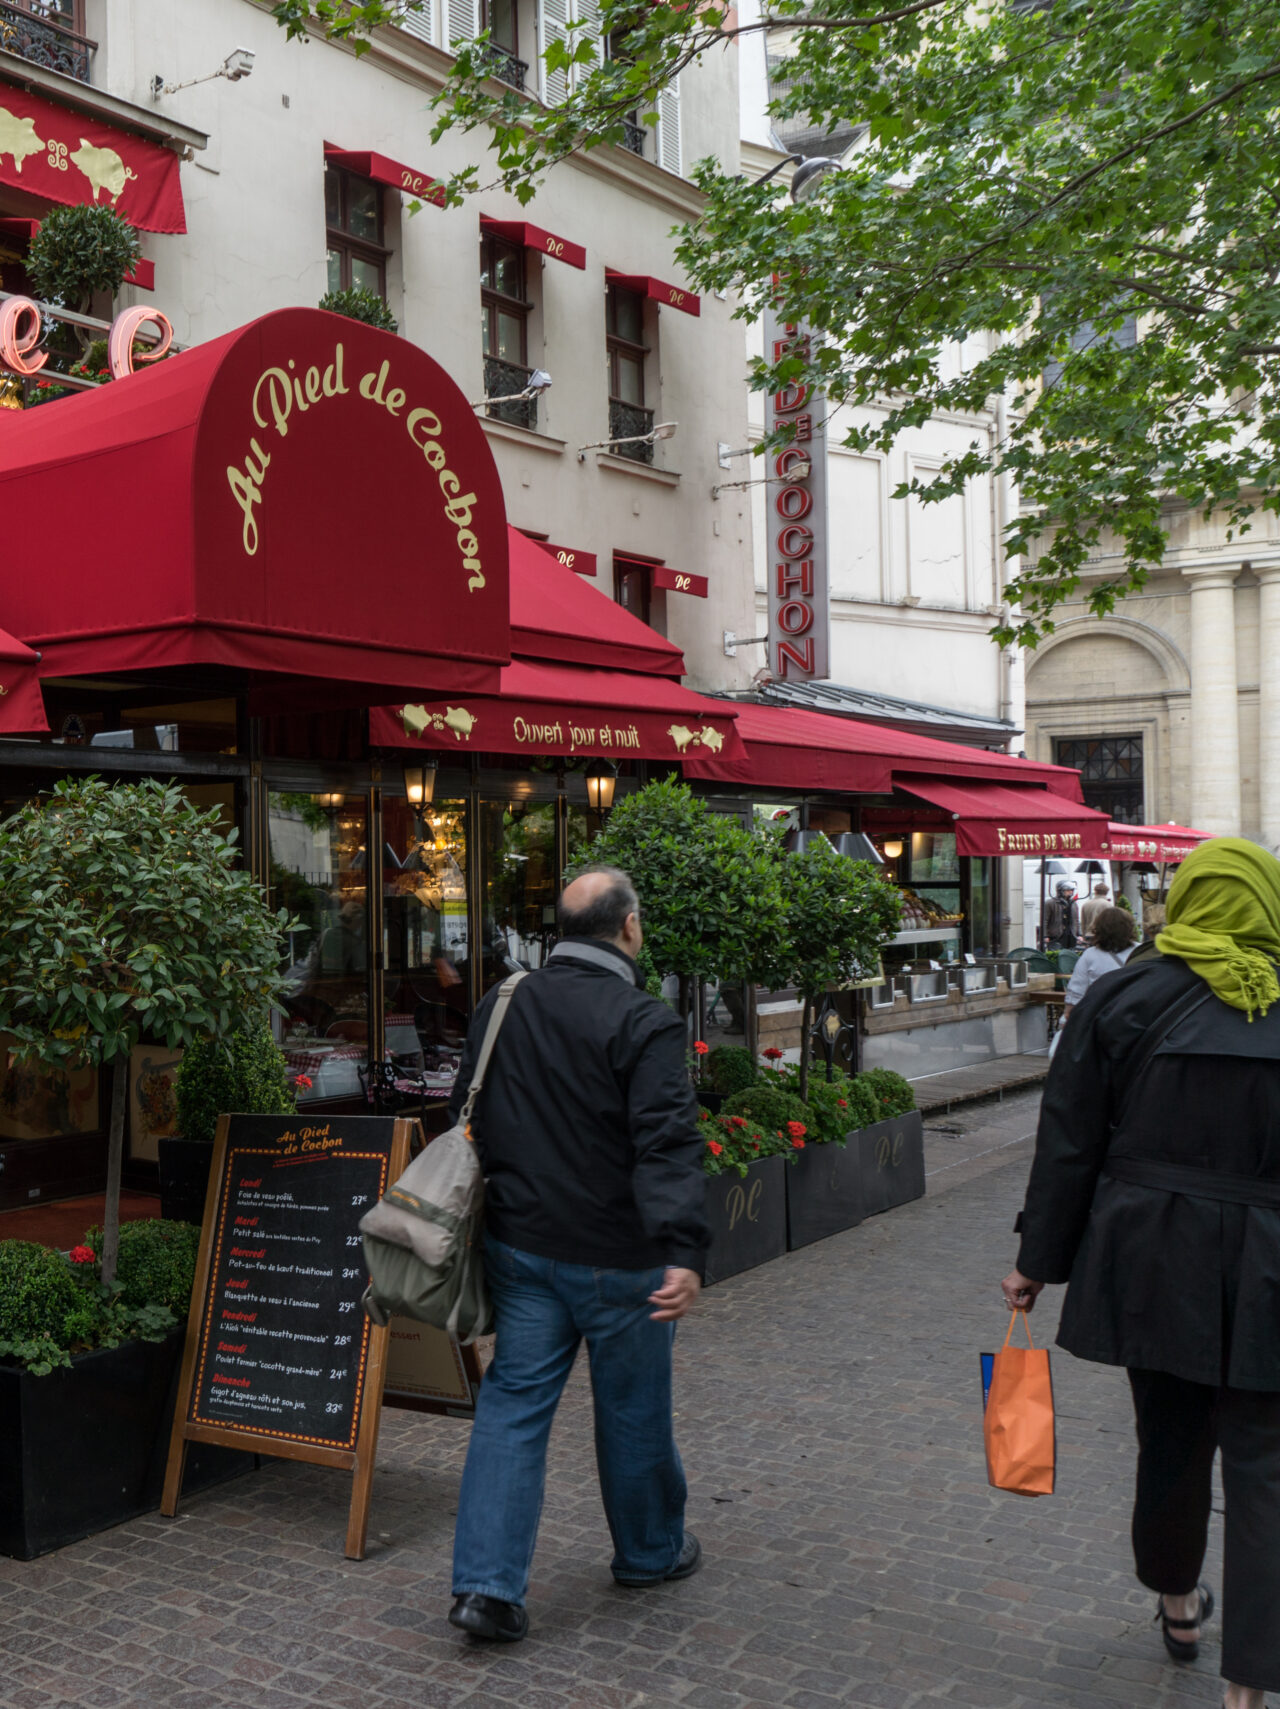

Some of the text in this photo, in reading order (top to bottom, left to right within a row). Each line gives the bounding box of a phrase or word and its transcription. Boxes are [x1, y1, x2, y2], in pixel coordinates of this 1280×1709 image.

[226, 342, 486, 593] Au Pied de Cochon
[775, 448, 814, 677] COCHON
[513, 716, 641, 752] Ouvert jour et nuit
[997, 828, 1082, 851] FRUITS DE MER
[276, 1124, 330, 1143] Au Pied
[283, 1137, 343, 1155] de Cochon
[239, 1178, 262, 1188] Lundi
[238, 1190, 252, 1199] Foie
[253, 1191, 261, 1200] de
[351, 1195, 368, 1206] 27€
[234, 1215, 259, 1226] Mardi
[233, 1228, 251, 1237] Petit
[252, 1230, 265, 1238] salé
[230, 1247, 267, 1259] Mercredi
[268, 1263, 275, 1271] de
[295, 1266, 333, 1277] traditionnel
[342, 1268, 360, 1278] 34€
[225, 1278, 249, 1289] Jeudi
[224, 1290, 258, 1302] Blanquette
[259, 1293, 267, 1302] de
[338, 1302, 356, 1312] 29€
[222, 1309, 258, 1322] Vendredi
[333, 1335, 352, 1346] 28€
[390, 1330, 421, 1341] essert
[217, 1341, 248, 1354] Samedi
[215, 1353, 236, 1364] Poulet
[329, 1369, 348, 1379] 24€
[212, 1373, 251, 1388] Dimanche
[211, 1386, 230, 1399] Gigot
[272, 1396, 280, 1405] et
[281, 1399, 293, 1407] son
[325, 1402, 343, 1413] 33€
